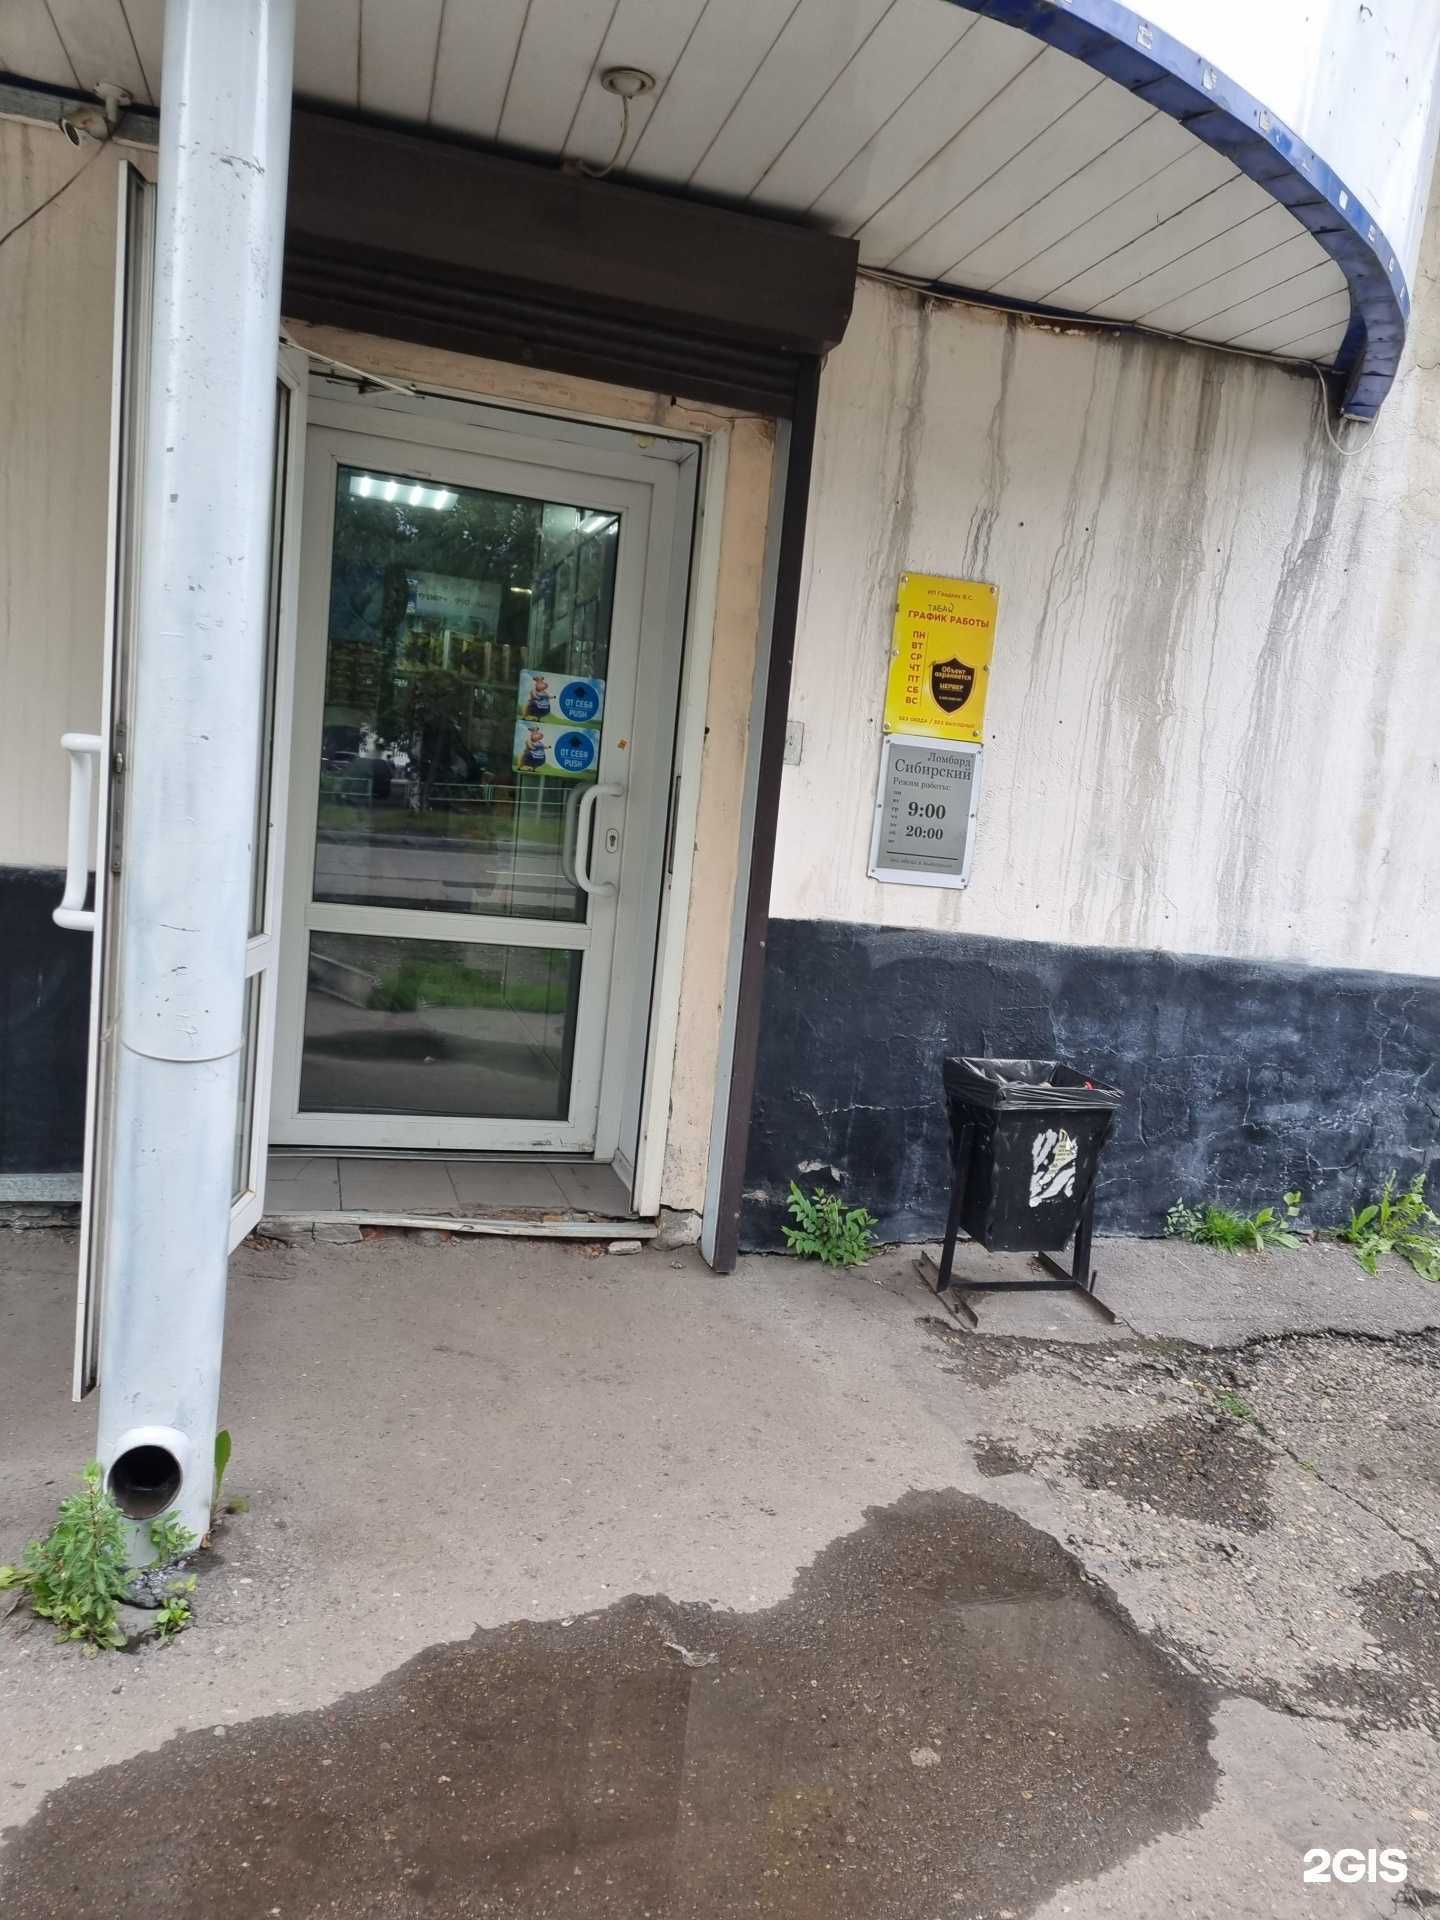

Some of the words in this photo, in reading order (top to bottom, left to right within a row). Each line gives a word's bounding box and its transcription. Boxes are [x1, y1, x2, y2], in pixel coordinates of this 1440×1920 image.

[908, 610, 947, 623] ГРАФИК
[950, 615, 990, 628] РАБОТЫ
[912, 630, 926, 640] ПН
[911, 641, 924, 649] ВТ
[910, 652, 922, 660] СР
[909, 663, 921, 671] ЧТ
[907, 674, 920, 683] ПТ
[906, 685, 919, 694] СБ
[575, 700, 593, 709] СЕБЯ
[905, 696, 918, 705] ВС
[569, 709, 588, 718] PUSH
[560, 748, 569, 756] ОТ
[570, 749, 589, 758] СЕБЯ
[564, 760, 583, 768] PUSH
[927, 752, 972, 769] Ломбард
[895, 758, 972, 781] Сибирский
[892, 776, 919, 787] Режим
[908, 801, 946, 820] 9:00
[905, 825, 943, 840] 20:00
